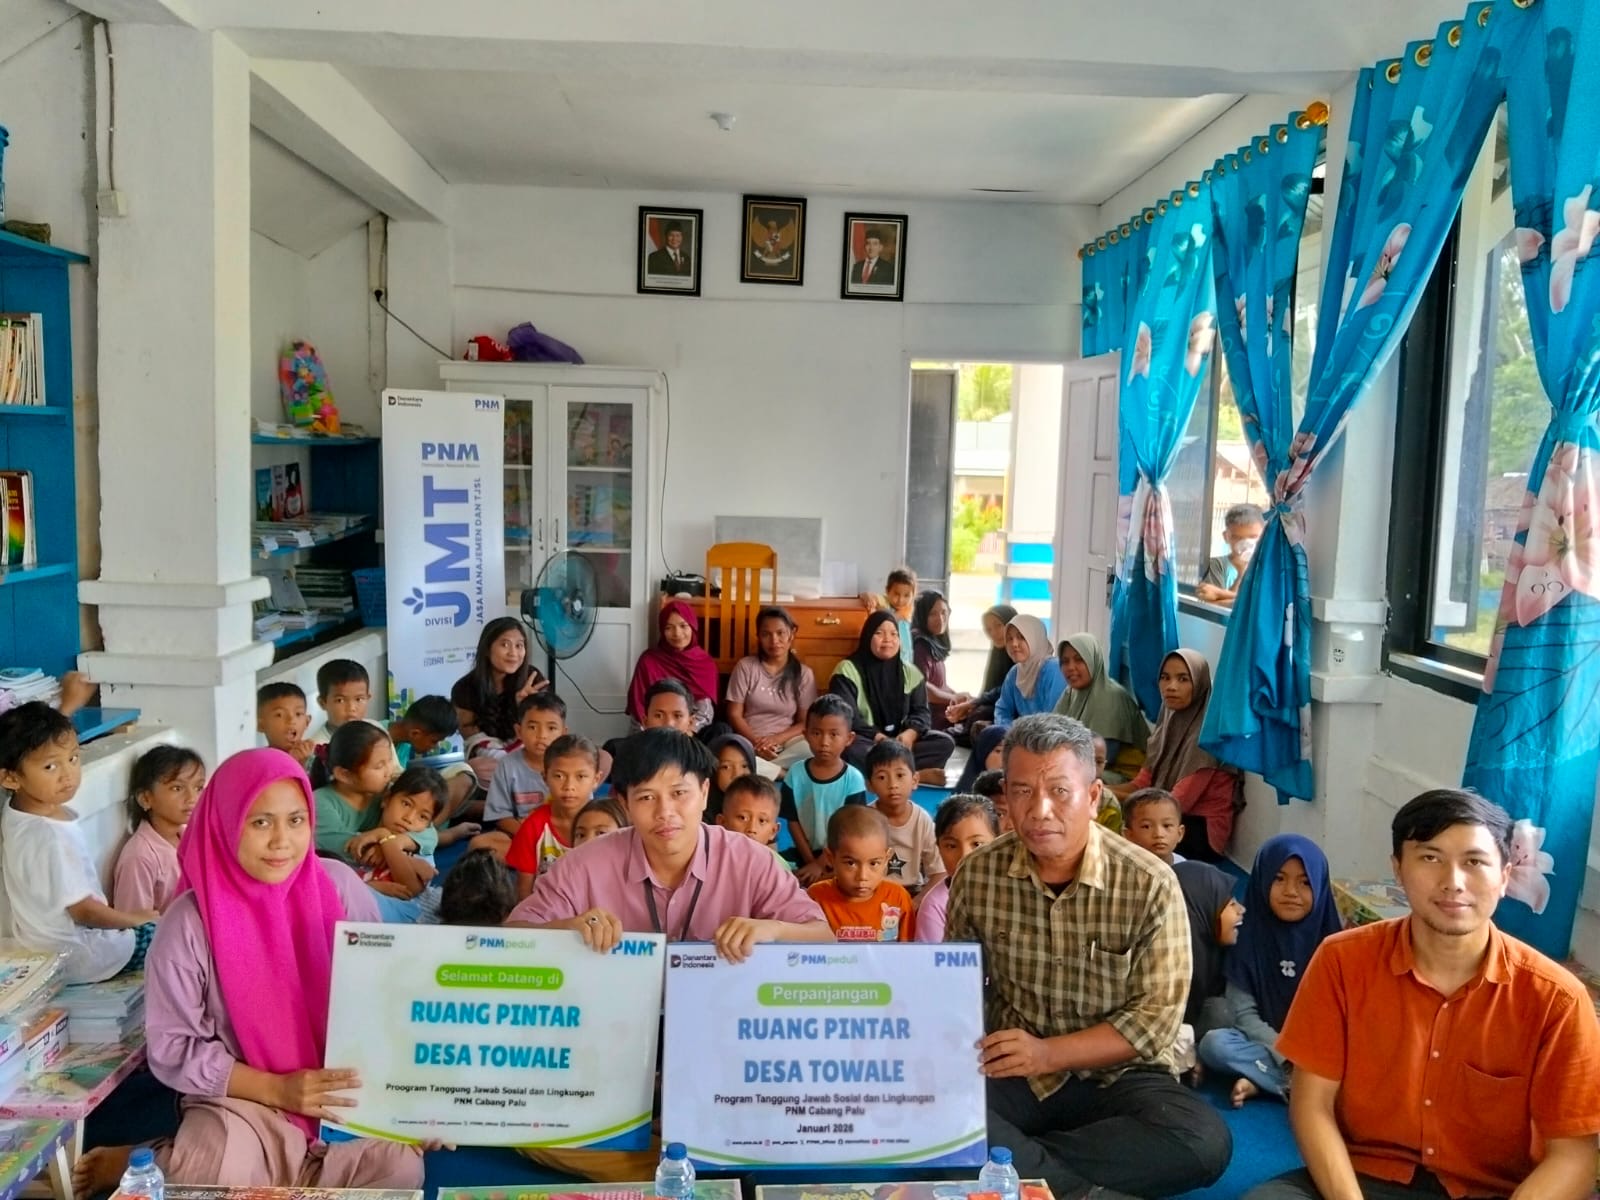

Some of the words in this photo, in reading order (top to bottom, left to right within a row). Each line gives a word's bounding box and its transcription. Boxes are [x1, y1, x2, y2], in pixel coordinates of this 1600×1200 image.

[475, 399, 500, 410] PNM
[421, 442, 480, 461] PNM
[474, 504, 482, 526] DAN
[423, 475, 471, 627] JMT
[475, 529, 483, 595] MANAJEMEN
[476, 599, 484, 624] JASA
[425, 617, 452, 626] DIVISI
[934, 951, 978, 967] PNM
[441, 969, 493, 983] Selamat
[498, 972, 543, 986] Datang
[548, 974, 559, 985] di
[773, 986, 878, 1003] Perpanjangan
[411, 1001, 490, 1024] RUANG
[496, 1004, 580, 1027] PINTAR
[737, 1017, 818, 1040] RUANG
[825, 1017, 910, 1040] PINTAR
[414, 1043, 471, 1066] DESA
[479, 1045, 571, 1068] TOWALE
[744, 1060, 801, 1083] DESA
[808, 1059, 904, 1083] TOWALE
[430, 1085, 471, 1094] Tanggung
[473, 1086, 499, 1094] Jawab
[502, 1086, 527, 1095] Sosial
[547, 1088, 595, 1098] Lingkungan
[714, 1094, 752, 1105] Program
[756, 1094, 800, 1105] Tanggung
[802, 1094, 831, 1103] Jawab
[833, 1094, 861, 1103] Sosial
[864, 1094, 880, 1103] dan
[882, 1094, 935, 1105] Lingkungan
[454, 1097, 472, 1105] PNM
[475, 1098, 505, 1108] Cabang
[509, 1098, 526, 1107] Palu
[785, 1106, 805, 1115] PNM
[808, 1106, 842, 1117] Cabang
[845, 1106, 865, 1115] Palu
[797, 1124, 830, 1133] Januari
[833, 1124, 854, 1133] 2026
